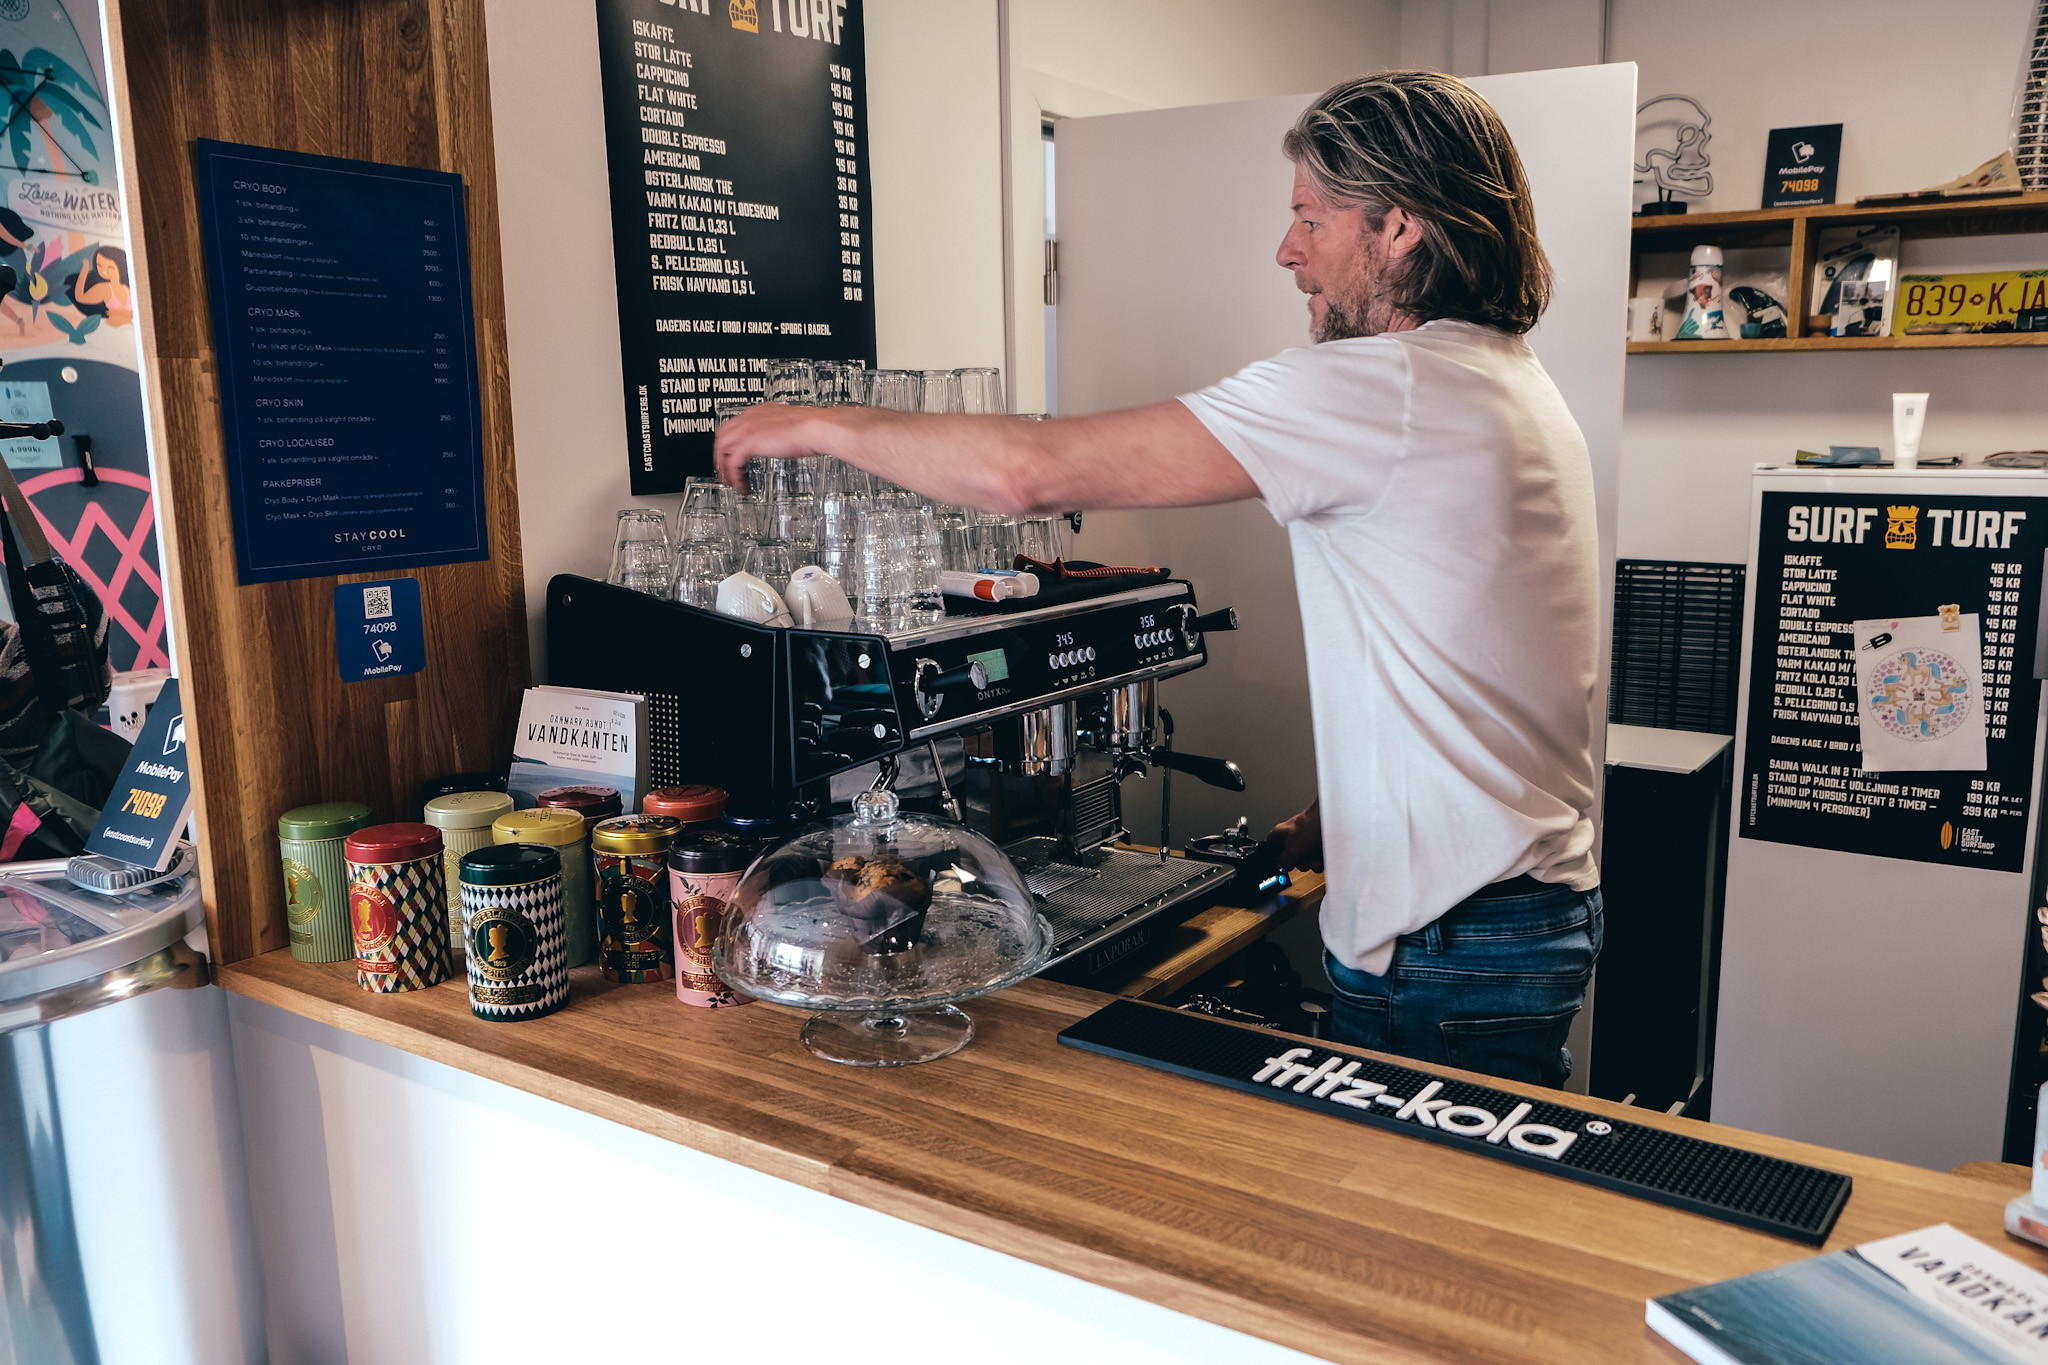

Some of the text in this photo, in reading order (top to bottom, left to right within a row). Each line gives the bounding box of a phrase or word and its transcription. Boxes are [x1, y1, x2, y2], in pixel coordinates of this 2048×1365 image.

[633, 19, 675, 43] ISKAFFE
[635, 41, 693, 68] STOR LATTE
[636, 63, 690, 88] CAPPUCINO
[829, 63, 852, 82] 45 KR
[638, 84, 698, 110] FLAT WHITE
[640, 106, 684, 128] CORTADO
[641, 127, 727, 155] DOUBLE ESPRESSO
[644, 149, 701, 171] AMERICANO
[1778, 165, 1825, 175] MobilePay
[233, 180, 288, 195] CRYO BODY
[716, 179, 734, 196] THE
[1781, 178, 1819, 193] 74098
[63, 191, 119, 212] WATER
[256, 202, 294, 213] behandling
[646, 191, 678, 209] VARM
[679, 194, 713, 213] KAKAO
[838, 194, 859, 211] 35 KR
[41, 209, 71, 220] NOTHING
[73, 211, 89, 220] ELSE
[258, 219, 303, 230] behandlinger
[648, 212, 728, 235] FRITZ KOLA 0,33
[264, 236, 308, 246] behandlinger
[650, 233, 718, 254] REDBULL 0,25
[651, 254, 740, 276] S. PELLEGRINO 0,5
[243, 266, 294, 279] Parbehandling
[245, 284, 309, 296] Gruppebehandling
[653, 275, 748, 296] FRISK HAVVAND 0,5
[853, 288, 863, 302] KR
[247, 307, 301, 318] CRYO MASK
[269, 327, 306, 336] behandling
[656, 319, 691, 332] DAGENS
[693, 320, 715, 333] KAGE
[747, 321, 773, 334] SNACK
[298, 344, 314, 352] Cryo
[659, 358, 746, 373] SAUNA WALK IN 2
[660, 378, 696, 394] STAND
[697, 378, 711, 393] UP
[713, 377, 746, 393] PADDLE
[256, 398, 304, 408] CRYO SKIN
[662, 398, 697, 414] STAND
[699, 398, 712, 413] UP
[276, 416, 314, 425] behandling
[663, 417, 715, 436] (MINIMUM
[638, 384, 653, 472] EASTCOASTSURFERS.DK
[259, 438, 335, 449] CRYO LOCALISED
[262, 477, 322, 488] PAKKEPRISER
[264, 497, 280, 505] Cryo
[281, 496, 299, 505] Body
[306, 495, 322, 504] Cryo
[322, 494, 339, 502] Mask
[1787, 504, 2027, 549] SURF TURF
[361, 544, 382, 552] CRYO
[1783, 554, 1822, 567] ISKAFFE
[1783, 567, 1838, 581] STOR LATTE
[1991, 562, 2022, 575] 45 KR
[1781, 580, 1831, 593] CAPPUCINO
[1781, 593, 1836, 607] FLAT WHITE
[1780, 606, 1820, 619] CORTADO
[363, 621, 397, 635] 74098
[1779, 619, 1813, 631] DOUBLE
[1778, 632, 1831, 646] AMERICANO
[363, 663, 403, 676] MobilePay
[1776, 657, 1836, 672] VARM KAKAO
[1775, 670, 1827, 685] FRITZ KOLA
[977, 687, 1002, 701] ONYX
[1775, 683, 1813, 696] REDBULL
[1784, 697, 1838, 711] PELLEGRINO
[550, 714, 583, 727] DANMARK
[585, 718, 606, 730] RUNDT
[1772, 708, 1842, 725] FRISK HAVVAND
[528, 722, 628, 754] VANDKANTEN
[135, 760, 185, 783] MobilePay
[1769, 759, 1828, 775] SAUNA WALK
[1768, 771, 1941, 800] STAND UP PADDLE UDLEJNING TIMER
[1971, 779, 2001, 793] 99 KR
[121, 788, 167, 819] 74098
[1767, 784, 1927, 811] STAND UP KURSUS EVENT TIMER
[1966, 792, 2000, 806] 199 KR
[1767, 795, 1871, 819] (MINIMUM 4 PERSONER)
[1962, 805, 1998, 819] 399 KR
[1961, 834, 1983, 843] COAST
[1962, 827, 1980, 836] EAST
[1961, 840, 1995, 850] SURFSHOP
